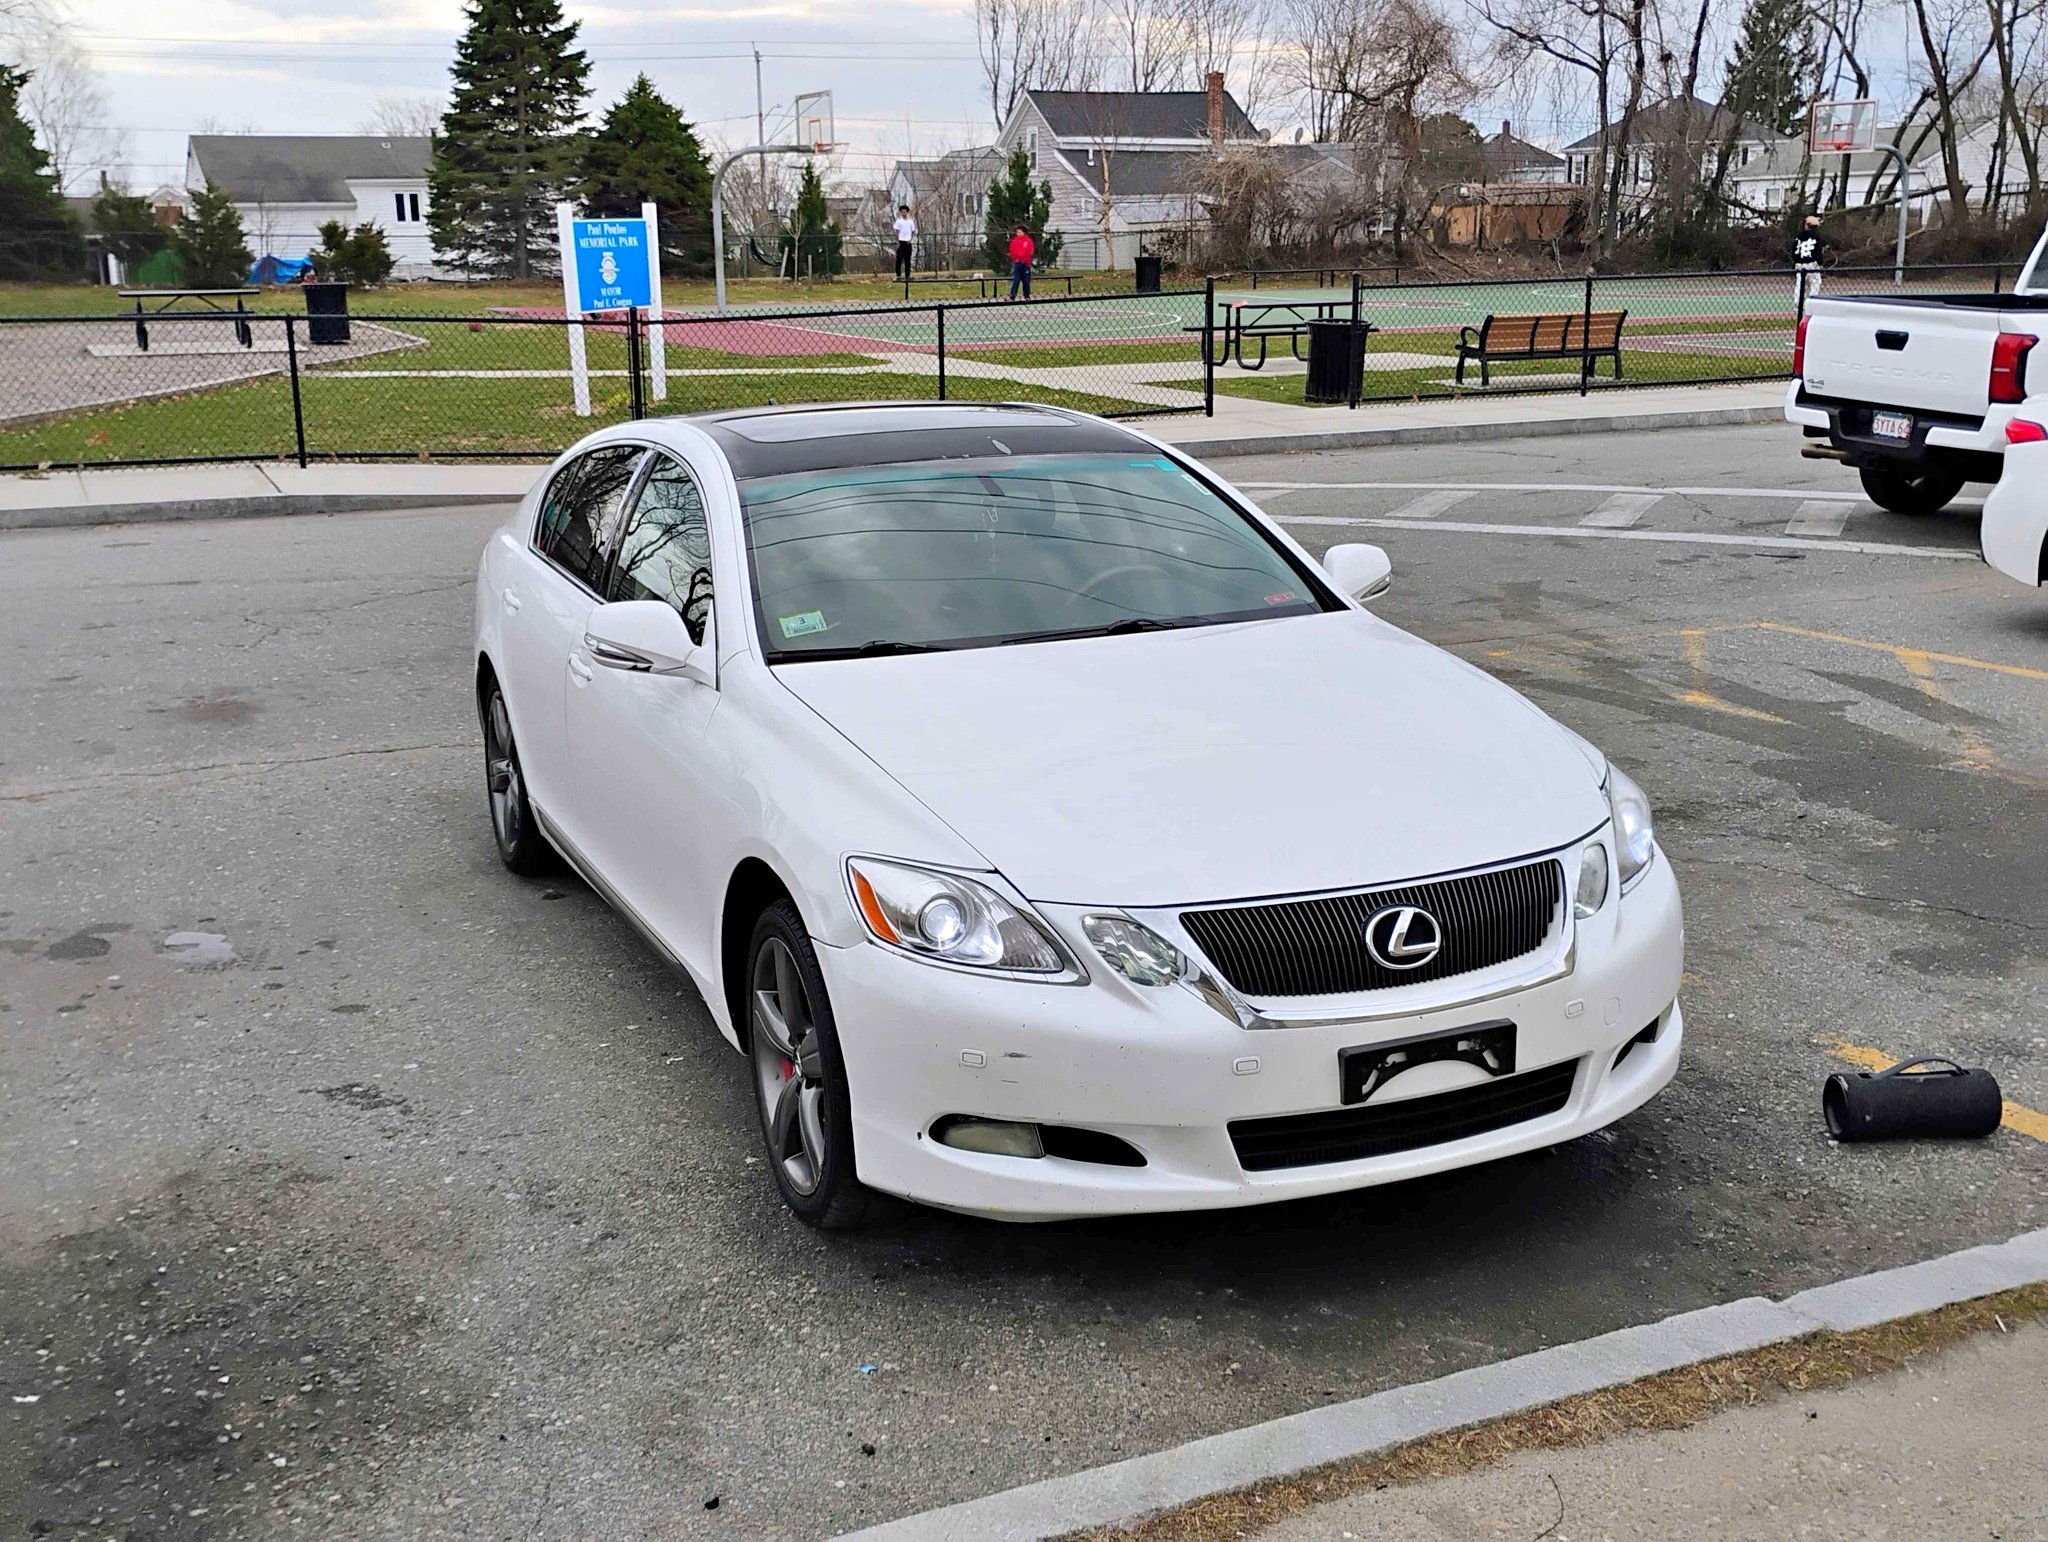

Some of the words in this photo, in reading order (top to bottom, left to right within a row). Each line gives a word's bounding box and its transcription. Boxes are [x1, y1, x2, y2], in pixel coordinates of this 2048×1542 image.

[587, 223, 601, 235] Paul
[603, 223, 627, 235] Poulos
[579, 237, 617, 249] MEMORIAL
[618, 236, 639, 248] PARK
[600, 286, 622, 297] MAYOR
[593, 299, 605, 308] Paul
[605, 298, 612, 307] E.
[1829, 361, 1955, 385] TACOMA
[798, 617, 806, 625] 3
